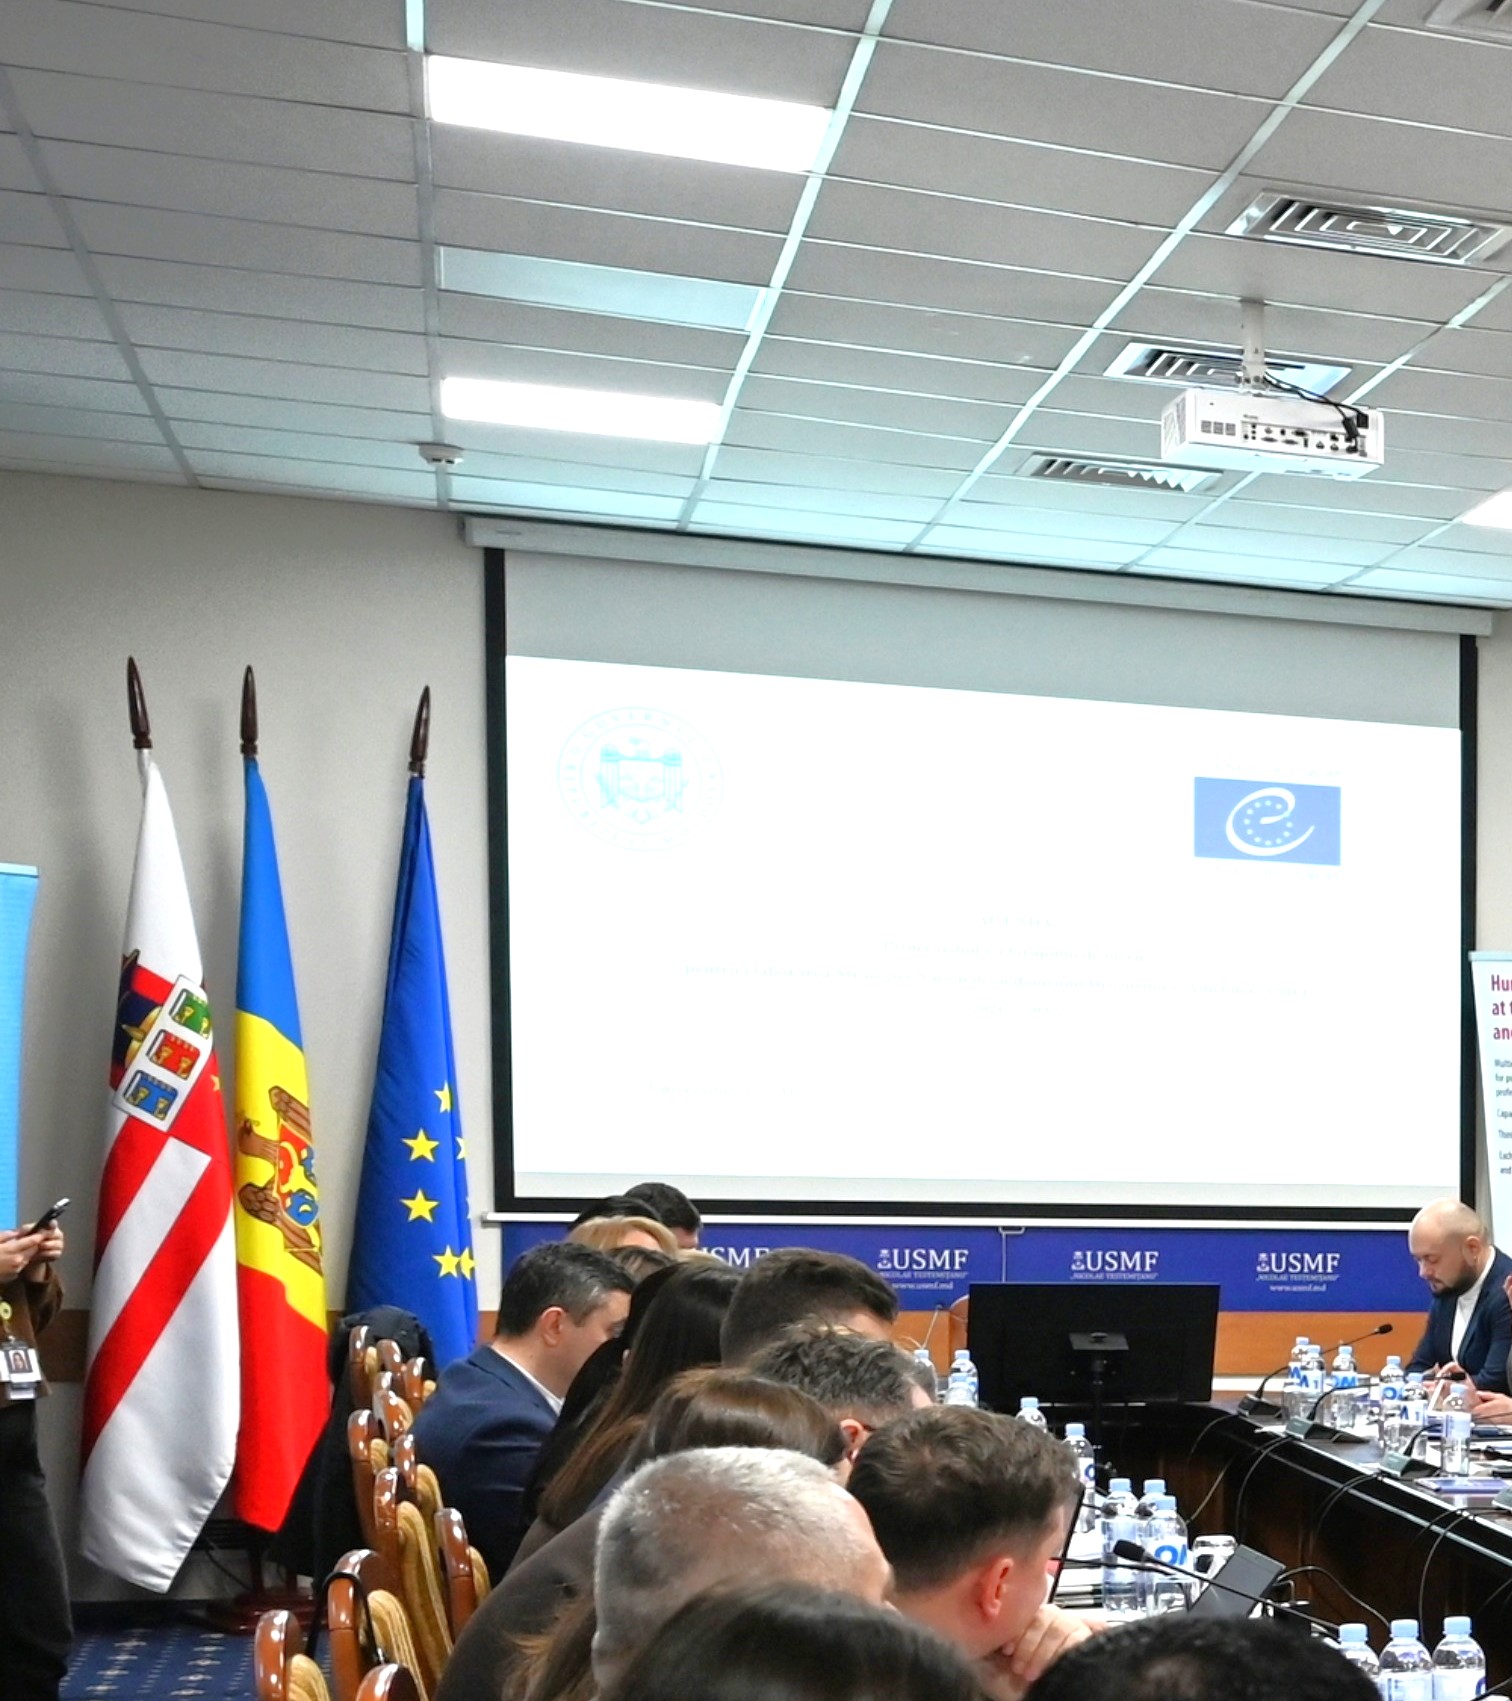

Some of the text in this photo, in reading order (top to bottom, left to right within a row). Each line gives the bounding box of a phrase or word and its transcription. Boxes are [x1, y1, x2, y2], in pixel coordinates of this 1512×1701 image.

[1492, 1001, 1506, 1017] at
[1495, 1073, 1504, 1082] for
[702, 1246, 770, 1269] SM
[893, 1248, 969, 1270] USMF
[1086, 1250, 1159, 1272] USMF
[1270, 1252, 1341, 1273] USMF
